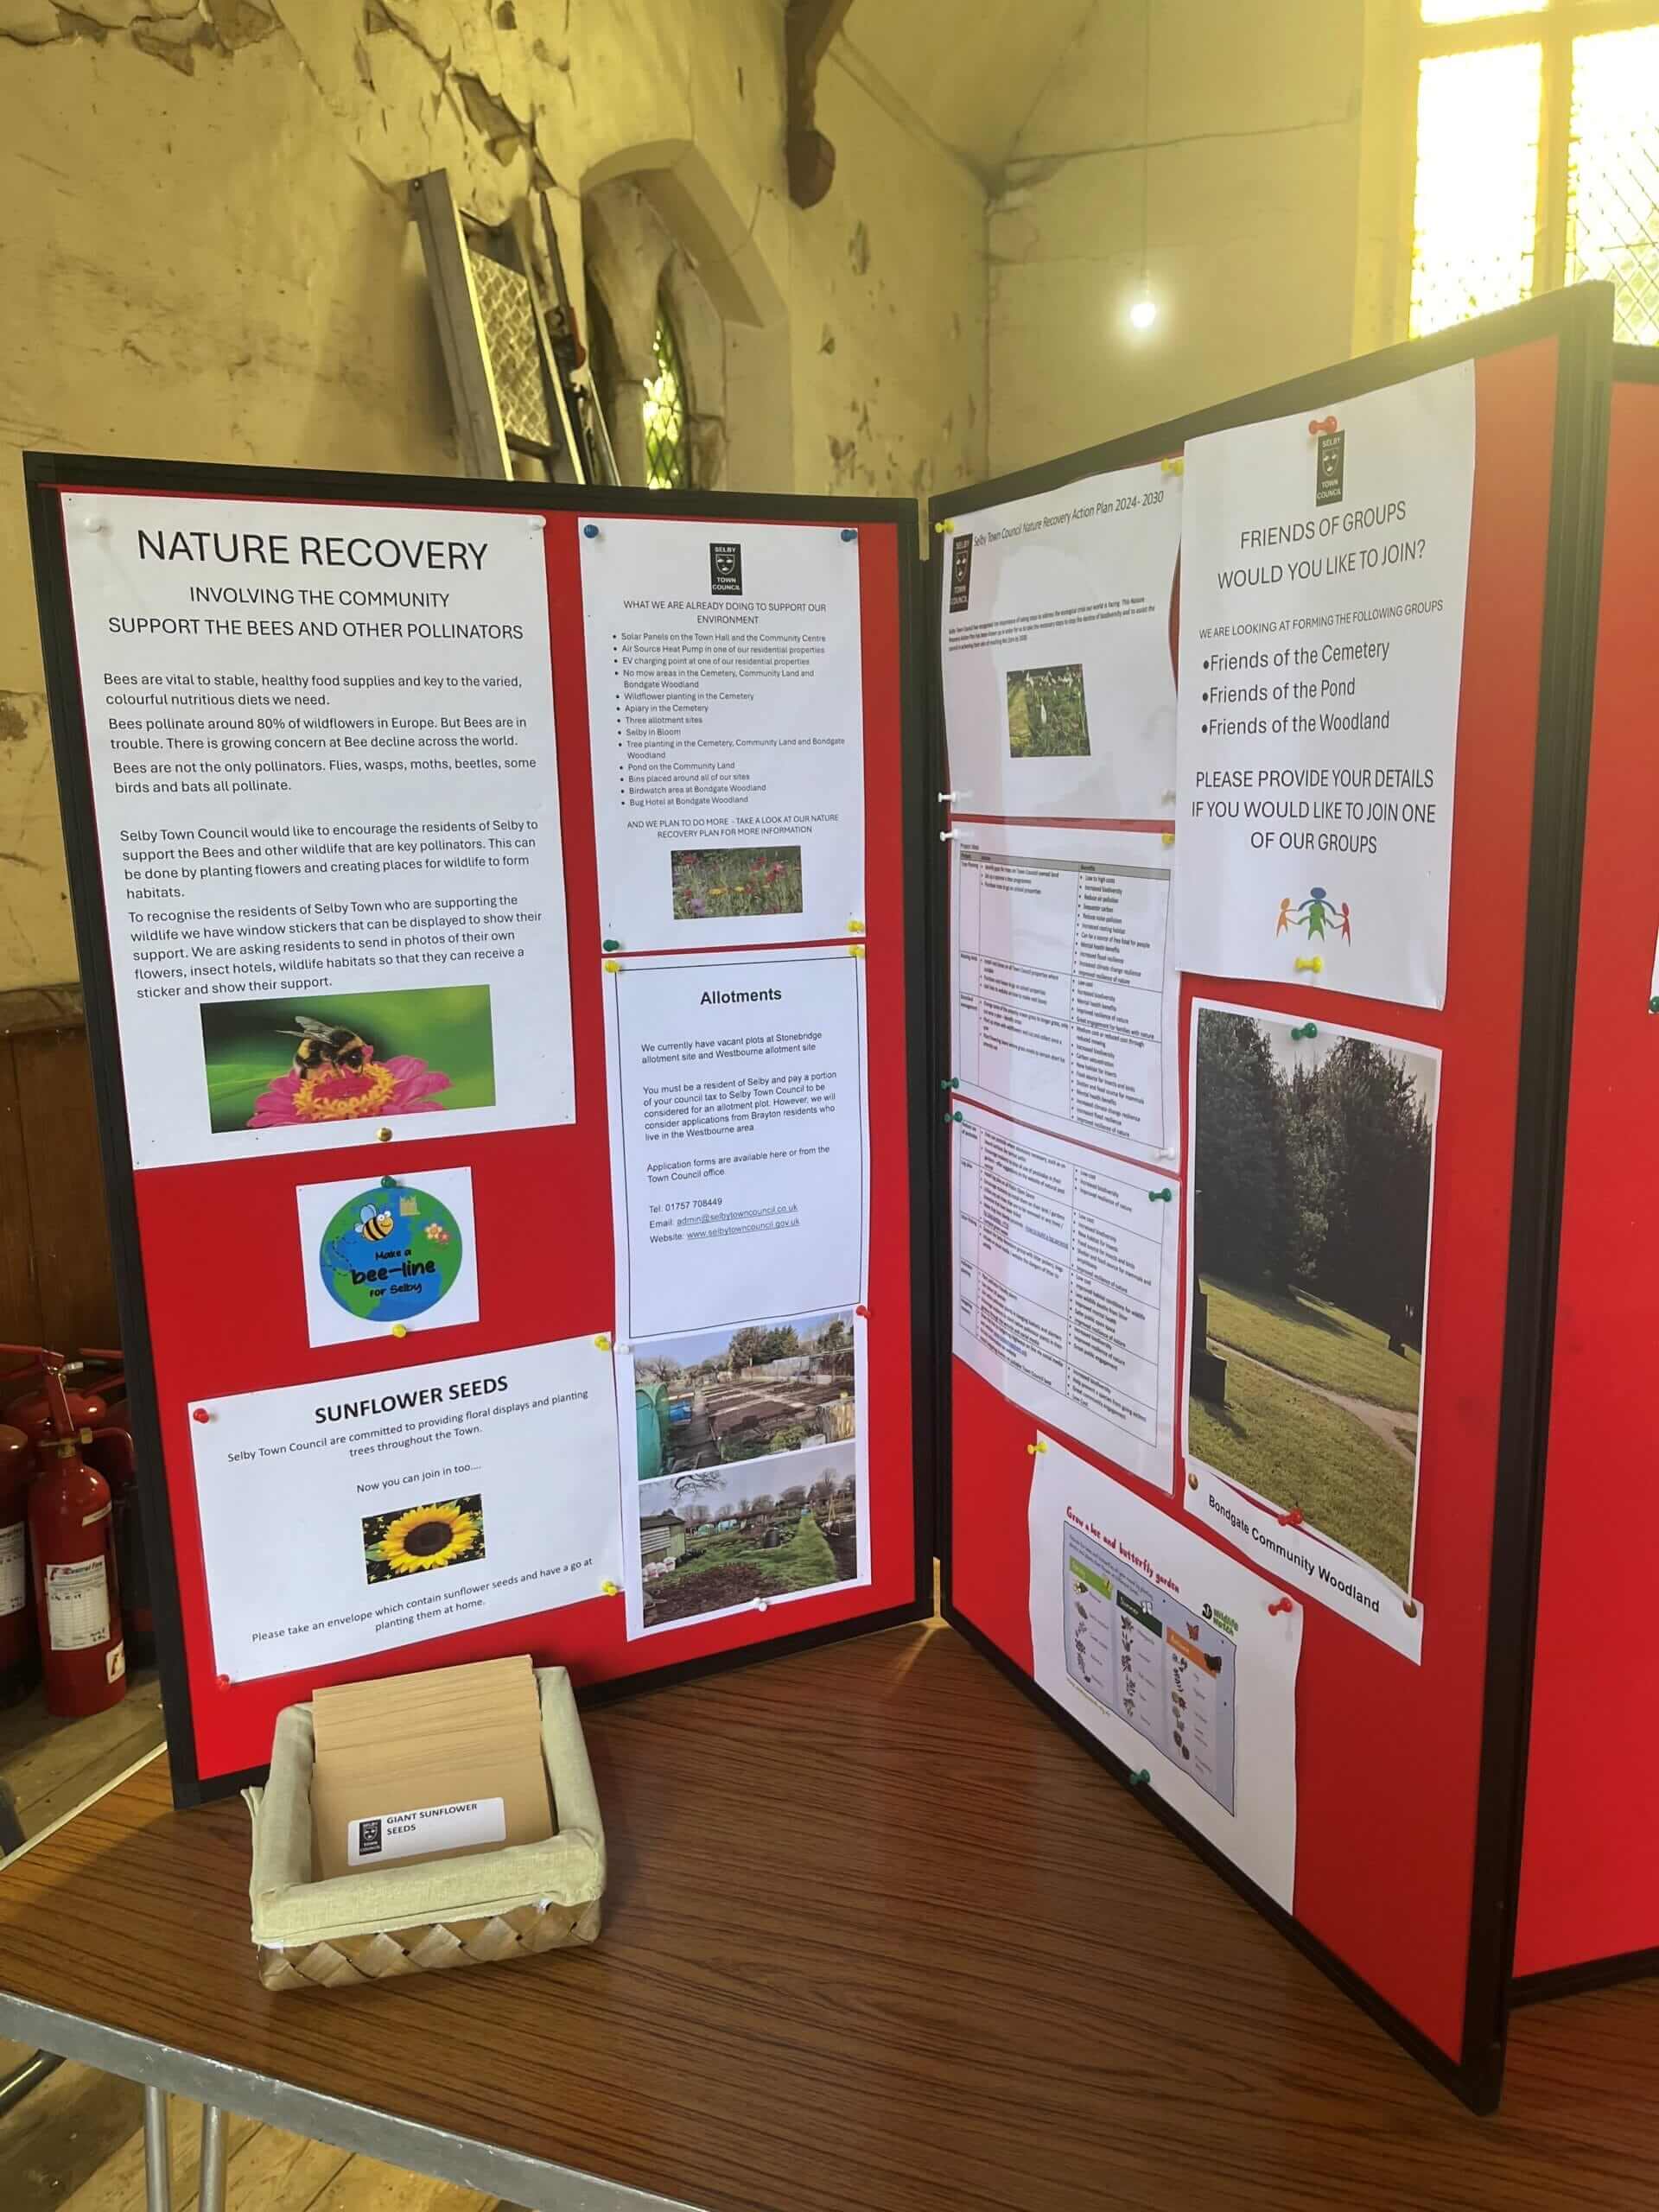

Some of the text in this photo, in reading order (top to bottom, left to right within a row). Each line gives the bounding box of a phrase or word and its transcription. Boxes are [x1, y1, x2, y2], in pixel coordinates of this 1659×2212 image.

[1001, 524, 1022, 540] Council
[1022, 520, 1043, 533] Nature
[1043, 510, 1071, 527] Recovery
[1072, 503, 1095, 519] Action
[1096, 501, 1114, 514] Plan
[1142, 491, 1165, 506] 2030
[1241, 501, 1406, 549] FRIENDS OF GROUPS
[138, 530, 487, 570] NATURE RECOVERY
[1217, 539, 1425, 589] WOULD YOU LIKE TO JOIN?
[190, 587, 449, 607] INVOLVING THE COMMUNITY
[623, 600, 650, 608] WHAT
[686, 601, 724, 610] ALREADY
[726, 602, 754, 611] DOING
[109, 617, 523, 639] SUPPORT THE BEES AND OTHER POLLINATORS
[697, 615, 759, 624] ENVIRONMENT
[1199, 600, 1443, 639] WE ARE LOOKING AT FORMING THE FOLLOWING GROUPS
[1211, 641, 1389, 671] Friends of the Cemetery
[104, 673, 521, 689] Bees are vital to stable, healthy food supplies and key to the varied,
[1211, 677, 1355, 703] Friends of the Pond
[626, 728, 647, 737] Selby
[1210, 710, 1389, 735] Friends of the Woodland
[1196, 769, 1433, 788] PLEASE PROVIDE YOUR DETAILS
[1192, 801, 1436, 823] IF YOU WOULD LIKE TO JOIN ONE
[1251, 832, 1376, 854] OF OUR GROUPS
[137, 977, 332, 998] sticker and show their support.
[701, 988, 781, 1005] Allotments
[658, 1042, 692, 1051] currently
[718, 1037, 743, 1046] vacant
[746, 1037, 764, 1046] plots
[776, 1032, 822, 1041] Stonebridge
[671, 1170, 701, 1180] Council
[665, 1201, 690, 1211] 01757
[693, 1198, 722, 1208] 708449
[375, 1250, 401, 1261] Make
[351, 1260, 435, 1286] bee-line
[370, 1283, 423, 1298] for Selby
[315, 1376, 507, 1423] SUNFLOWER SEEDS
[228, 1451, 256, 1464] Selby
[258, 1446, 286, 1457] Town
[289, 1438, 327, 1452] Council
[330, 1436, 346, 1445] are
[349, 1424, 403, 1442] committed
[418, 1414, 463, 1431] providing
[466, 1408, 490, 1420] floral
[493, 1402, 530, 1414] displays
[532, 1396, 550, 1408] and
[552, 1391, 588, 1406] planting
[349, 1427, 481, 1457] trees throughout the Town.
[1067, 1506, 1084, 1528] Grow
[1103, 1536, 1116, 1549] and
[1120, 1542, 1154, 1578] butterfly
[1155, 1573, 1179, 1593] garden
[1209, 1494, 1380, 1614] Bondgate Community Woodland
[386, 1803, 478, 1824] GIANT SUNFLOWER
[386, 1824, 416, 1835] SEEDS
